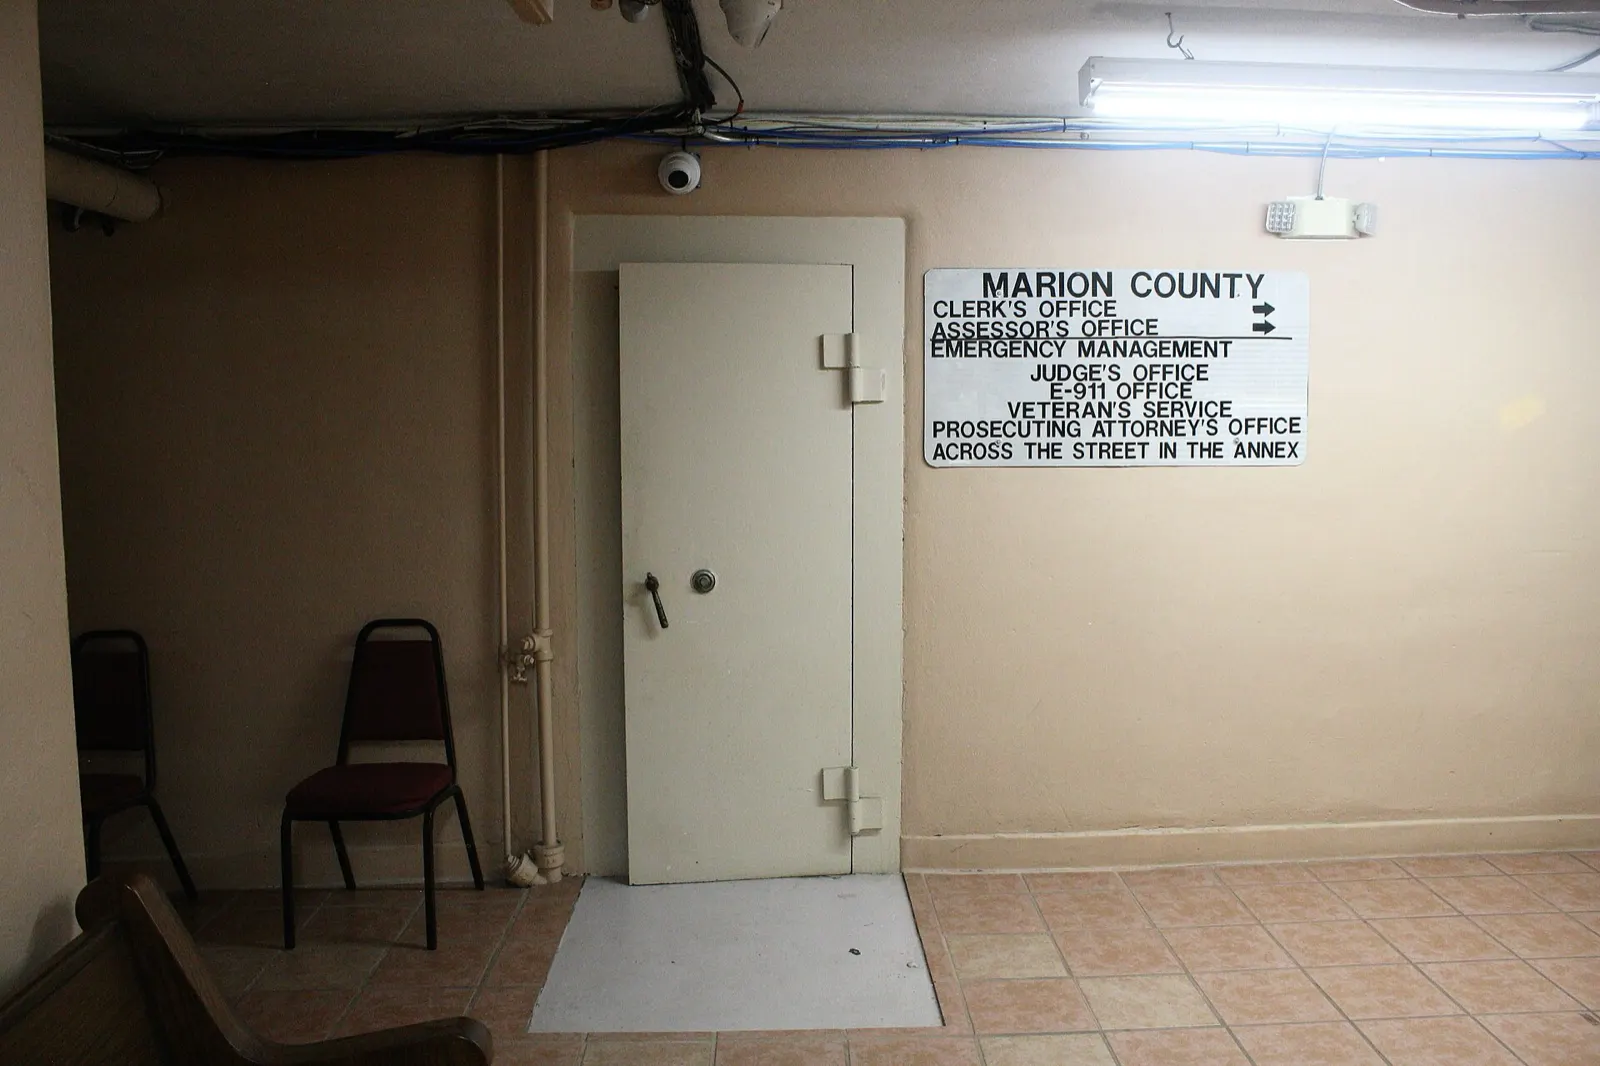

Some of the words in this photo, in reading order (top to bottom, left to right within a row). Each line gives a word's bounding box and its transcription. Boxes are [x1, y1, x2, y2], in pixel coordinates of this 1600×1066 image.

[982, 272, 1113, 298] MARION
[1131, 273, 1265, 299] COUNTY
[933, 301, 1026, 318] CLERK'S
[1039, 301, 1117, 318] OFFICE
[931, 321, 1069, 338] ASSESSOR'S
[1081, 319, 1158, 336] OFFICE
[931, 341, 1065, 358] EMERGENCY
[1078, 341, 1232, 358] MANAGEMENT
[1030, 365, 1121, 382] JUDGE'S
[1133, 364, 1209, 382] OFFICE
[1050, 383, 1106, 400] E-911
[1117, 383, 1192, 400] OFFICE
[1008, 402, 1130, 419] VETERAN'S
[1143, 401, 1232, 418] SERVICE
[932, 421, 1081, 438] PROSECUTING
[1092, 419, 1217, 438] ATTORNEY'S
[1229, 418, 1301, 435] OFFICE
[932, 443, 1012, 461] ACROSS
[1027, 443, 1063, 460] THE
[1073, 443, 1147, 460] STREET
[1159, 443, 1176, 459] IN
[1187, 442, 1223, 459] THE
[1234, 442, 1299, 459] ANNEX
